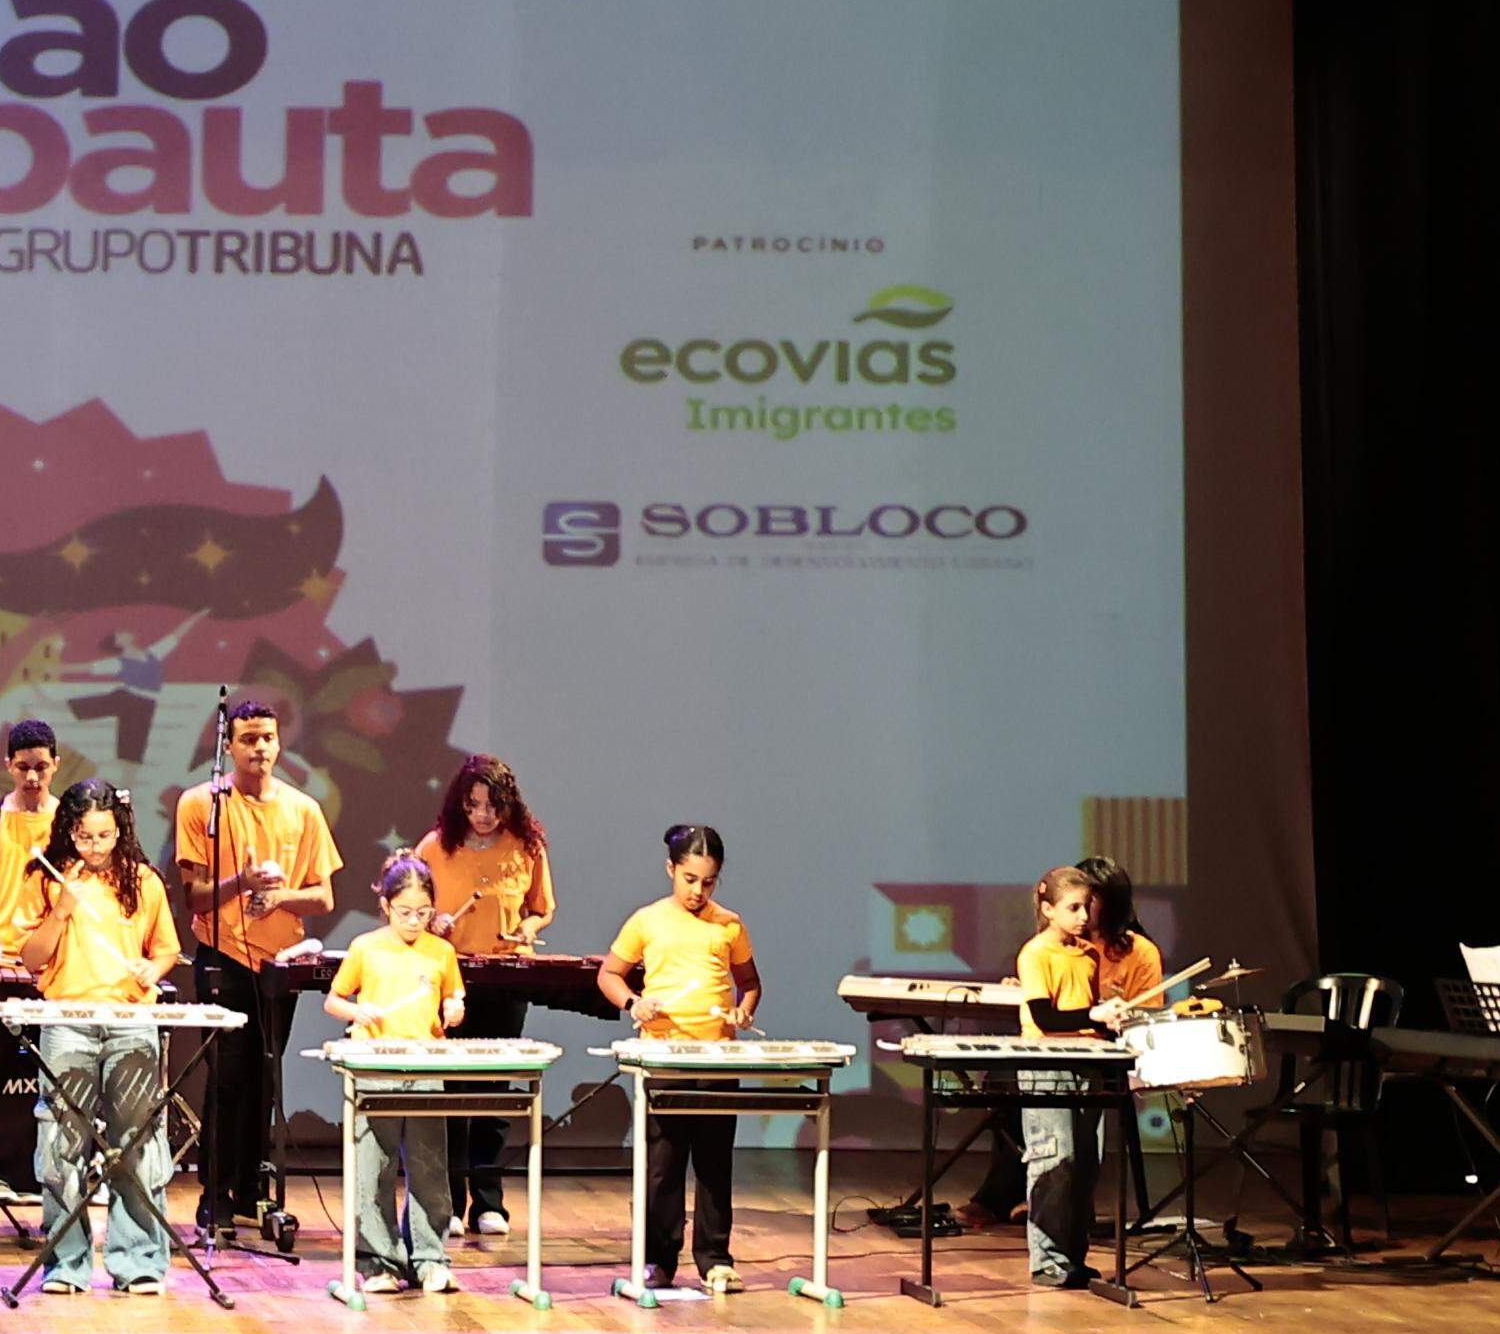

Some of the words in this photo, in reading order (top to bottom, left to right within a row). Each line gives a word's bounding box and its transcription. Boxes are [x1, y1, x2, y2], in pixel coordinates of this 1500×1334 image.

[691, 235, 886, 255] PATROCÍNIO
[619, 337, 958, 386] ecovias
[684, 394, 957, 442] Imigrantes
[638, 502, 1030, 541] SOBLOCO
